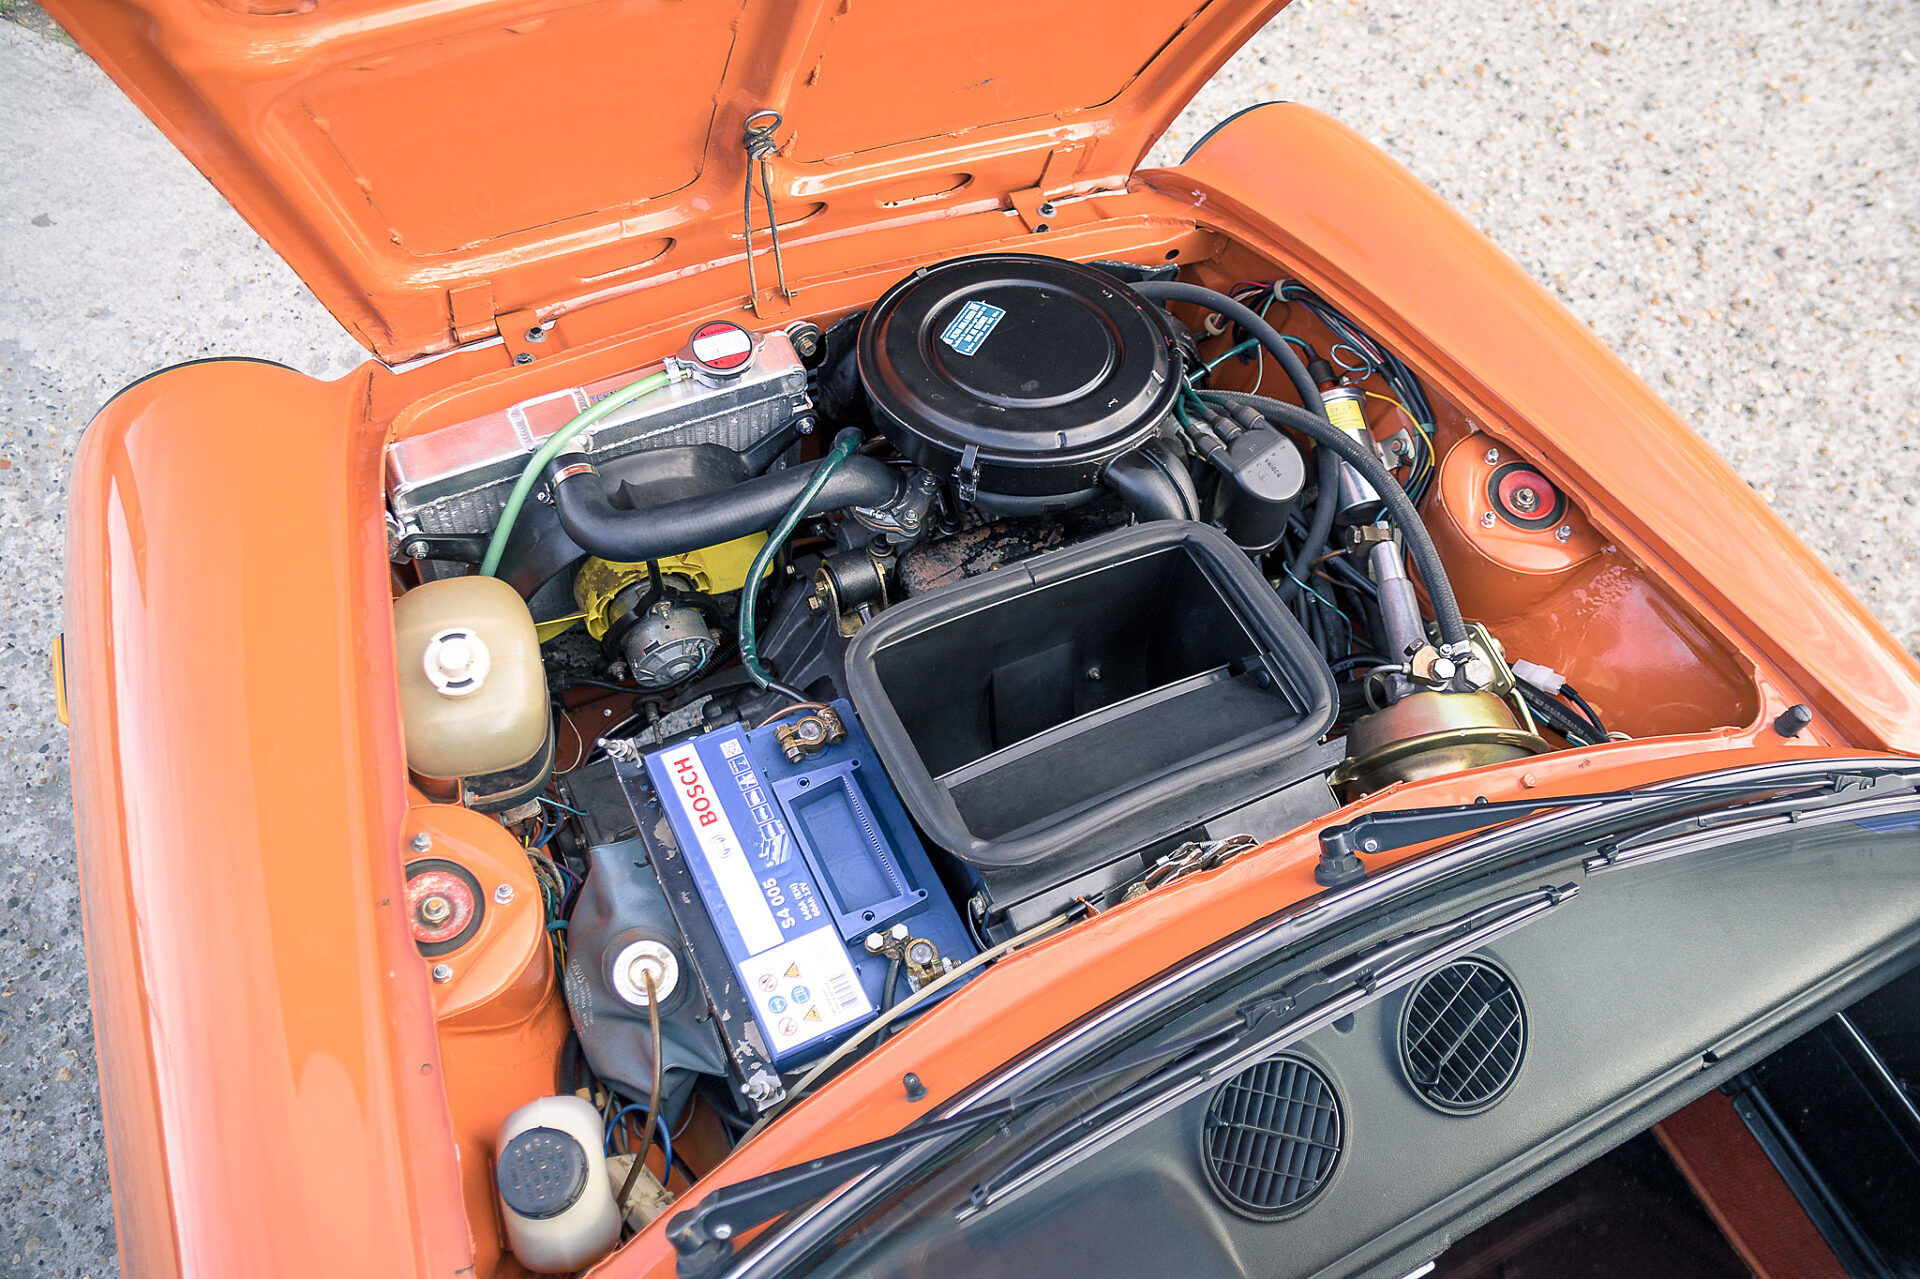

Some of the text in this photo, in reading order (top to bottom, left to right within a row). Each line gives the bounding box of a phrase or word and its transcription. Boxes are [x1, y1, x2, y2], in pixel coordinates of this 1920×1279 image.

[674, 757, 718, 827] BOSCH
[762, 877, 796, 929] S4 005
[798, 882, 821, 917] 60Ah 12V
